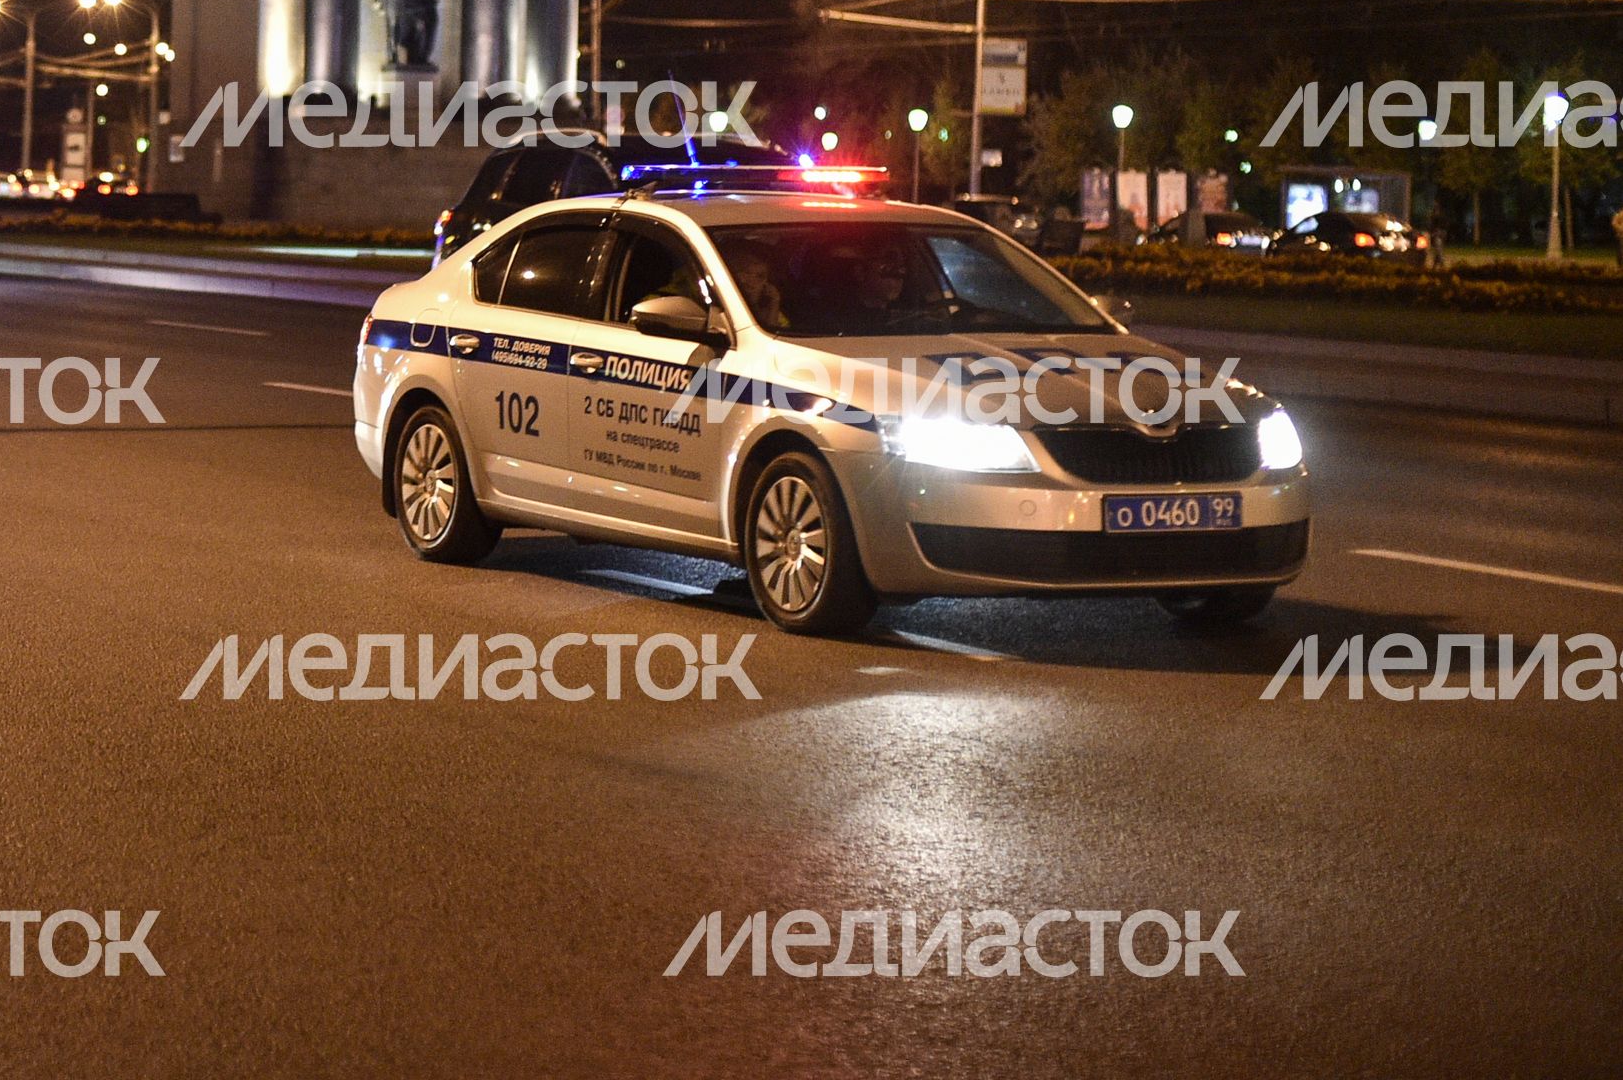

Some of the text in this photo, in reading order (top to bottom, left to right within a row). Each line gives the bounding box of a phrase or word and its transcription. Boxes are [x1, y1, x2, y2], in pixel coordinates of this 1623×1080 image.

[493, 337, 551, 356] ТЕЛ. ДОВЕРИЯ
[604, 355, 692, 393] ПОЛИЦИЯ
[495, 390, 540, 437] 102
[584, 396, 702, 437] 2 СБ ДПС ГИБДД
[606, 430, 680, 453] на спецтрассе
[584, 449, 594, 461] ГУ
[596, 451, 615, 467] МВД
[617, 454, 646, 470] России
[648, 463, 658, 473] по
[1141, 499, 1201, 528] 0460
[1212, 497, 1235, 518] 99
